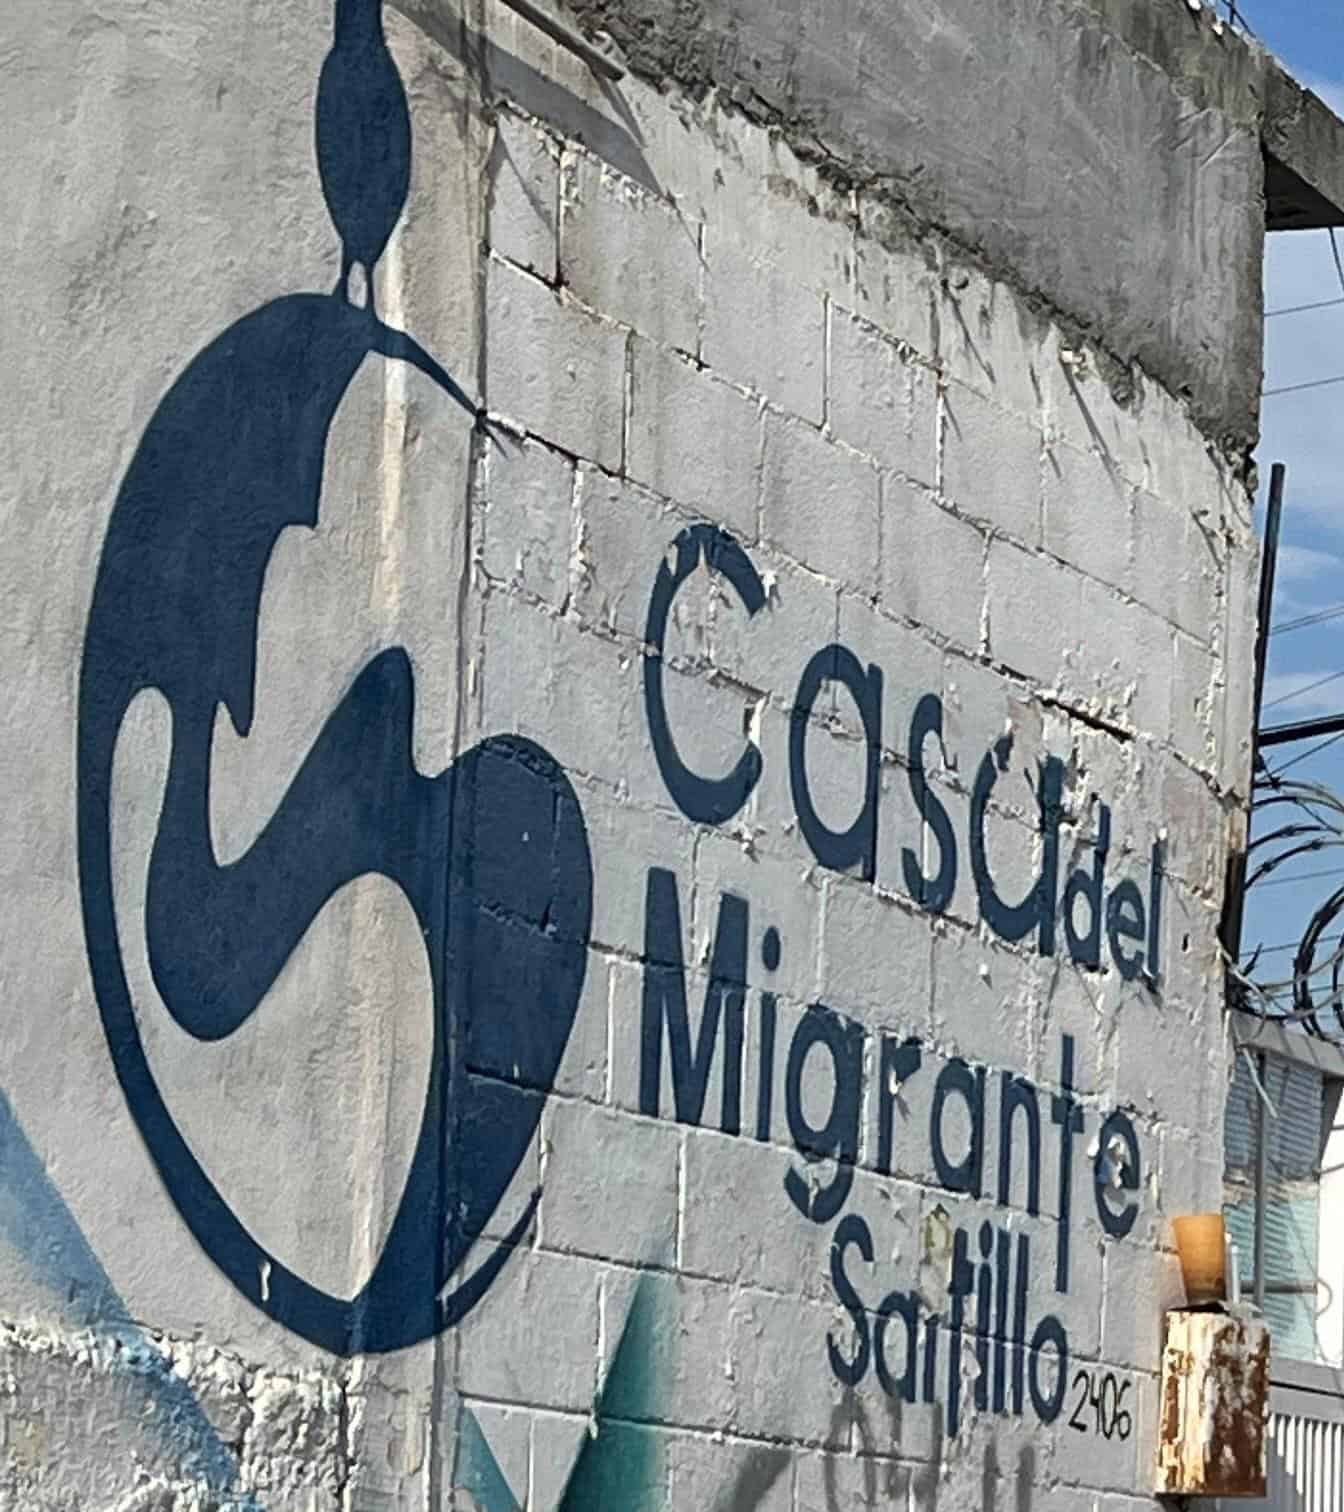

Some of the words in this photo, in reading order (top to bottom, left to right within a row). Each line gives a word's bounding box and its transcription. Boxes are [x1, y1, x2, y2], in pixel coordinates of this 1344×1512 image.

[643, 522, 1066, 957] Casa
[1062, 805, 1168, 981] del
[639, 866, 1142, 1294] Migrante
[1070, 1369, 1133, 1441] 2406
